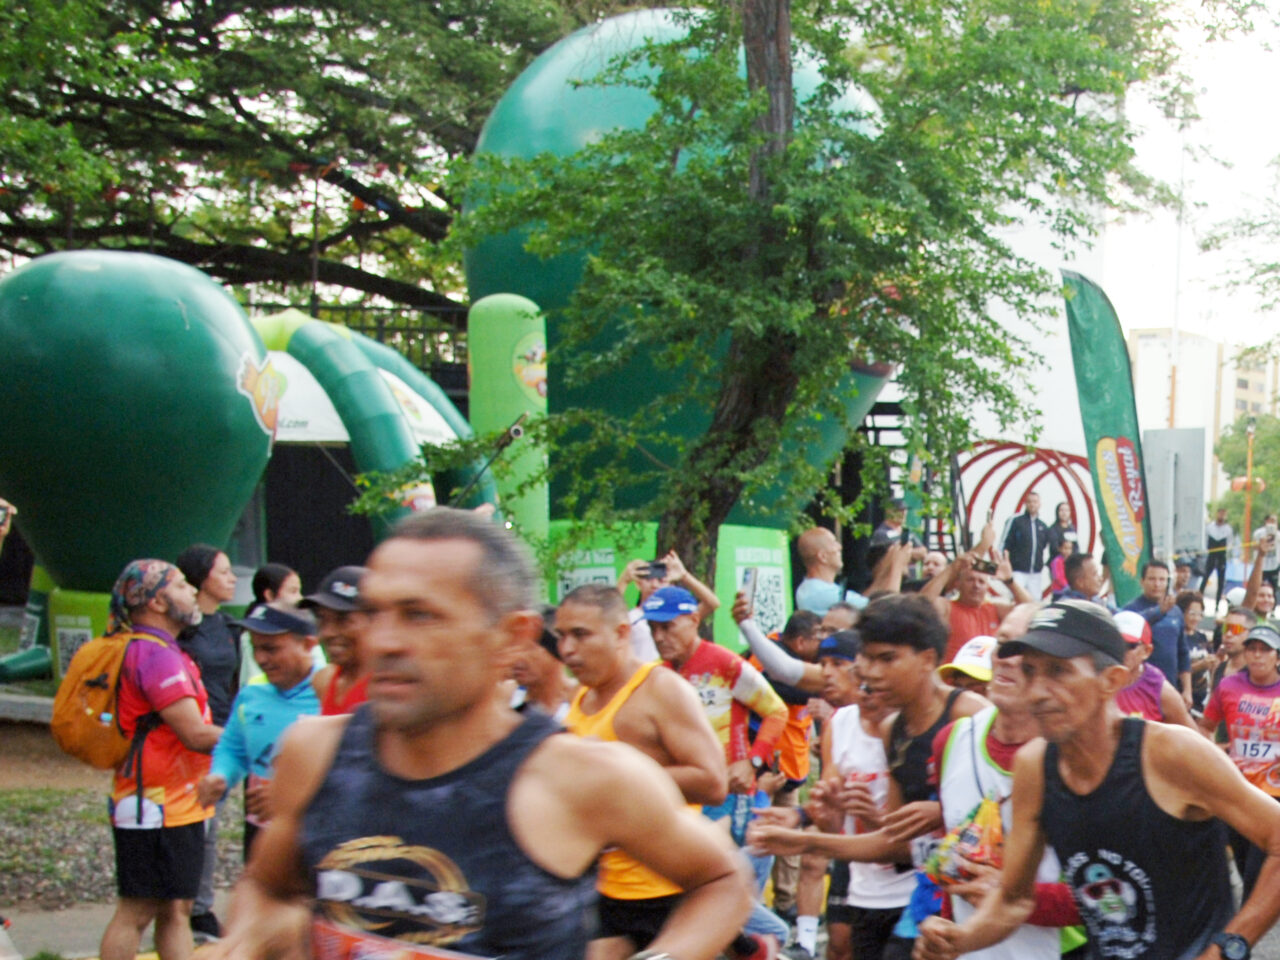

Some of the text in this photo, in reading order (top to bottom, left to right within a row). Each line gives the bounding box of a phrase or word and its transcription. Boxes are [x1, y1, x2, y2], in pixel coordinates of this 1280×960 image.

[1117, 446, 1143, 512] Royal
[1237, 700, 1271, 717] Chivo
[1243, 743, 1272, 758] 157
